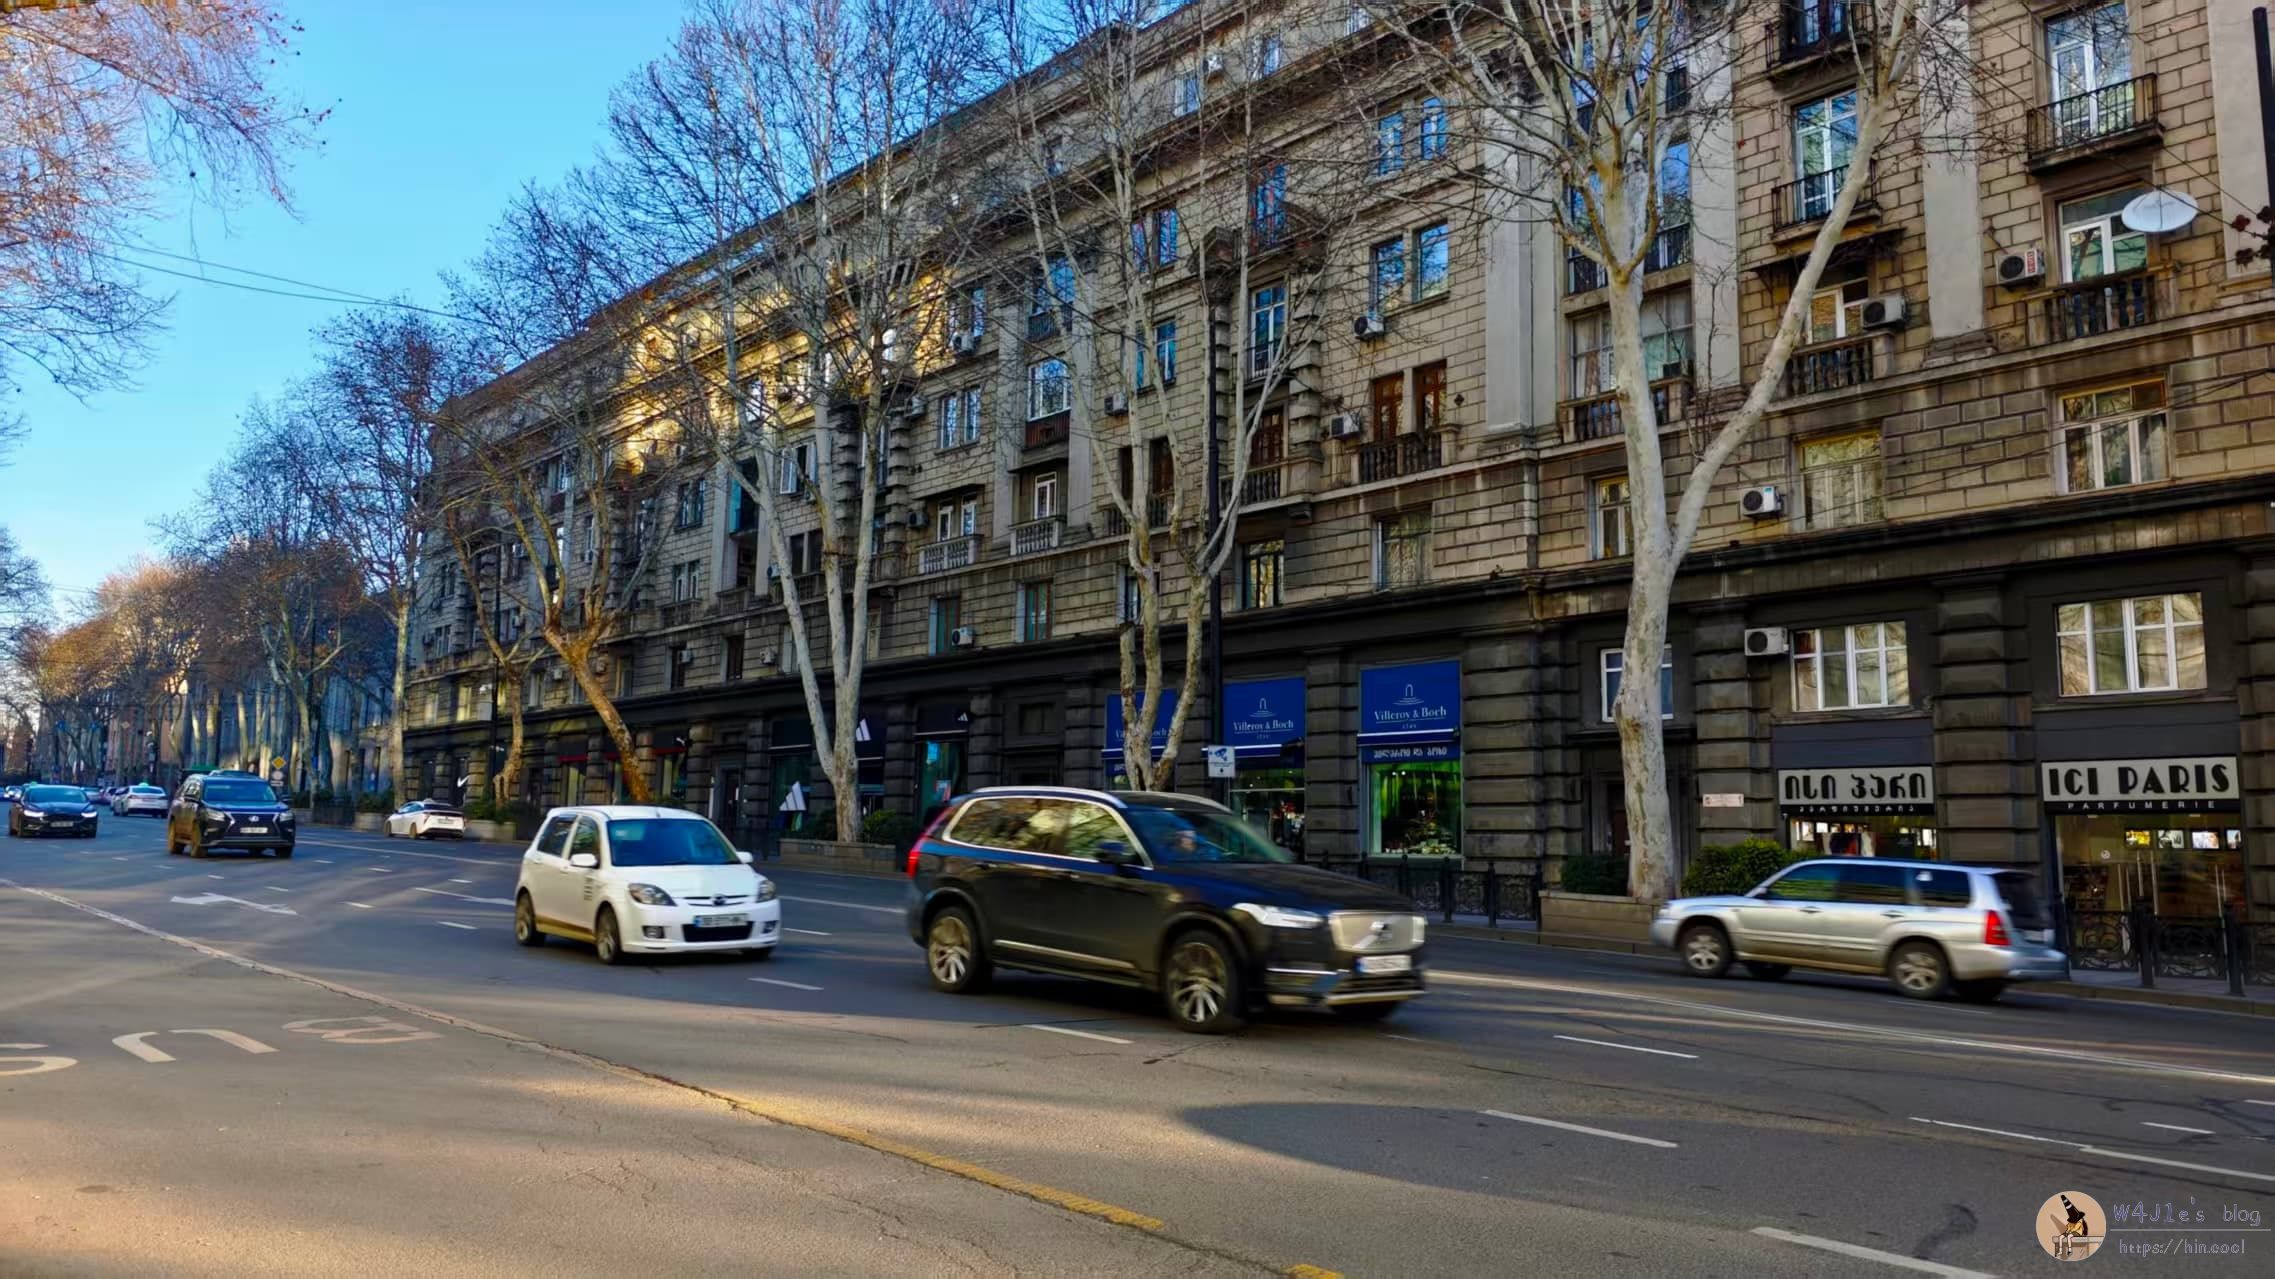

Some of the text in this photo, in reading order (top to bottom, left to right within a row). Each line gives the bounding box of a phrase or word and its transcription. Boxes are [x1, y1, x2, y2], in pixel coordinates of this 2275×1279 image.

[1421, 705, 1447, 718] Boch
[1272, 719, 1294, 730] Boch
[1784, 772, 1927, 800] ისი პარი
[2049, 764, 2230, 796] ICI PARIS
[2067, 801, 2215, 810] PARFUMERIE
